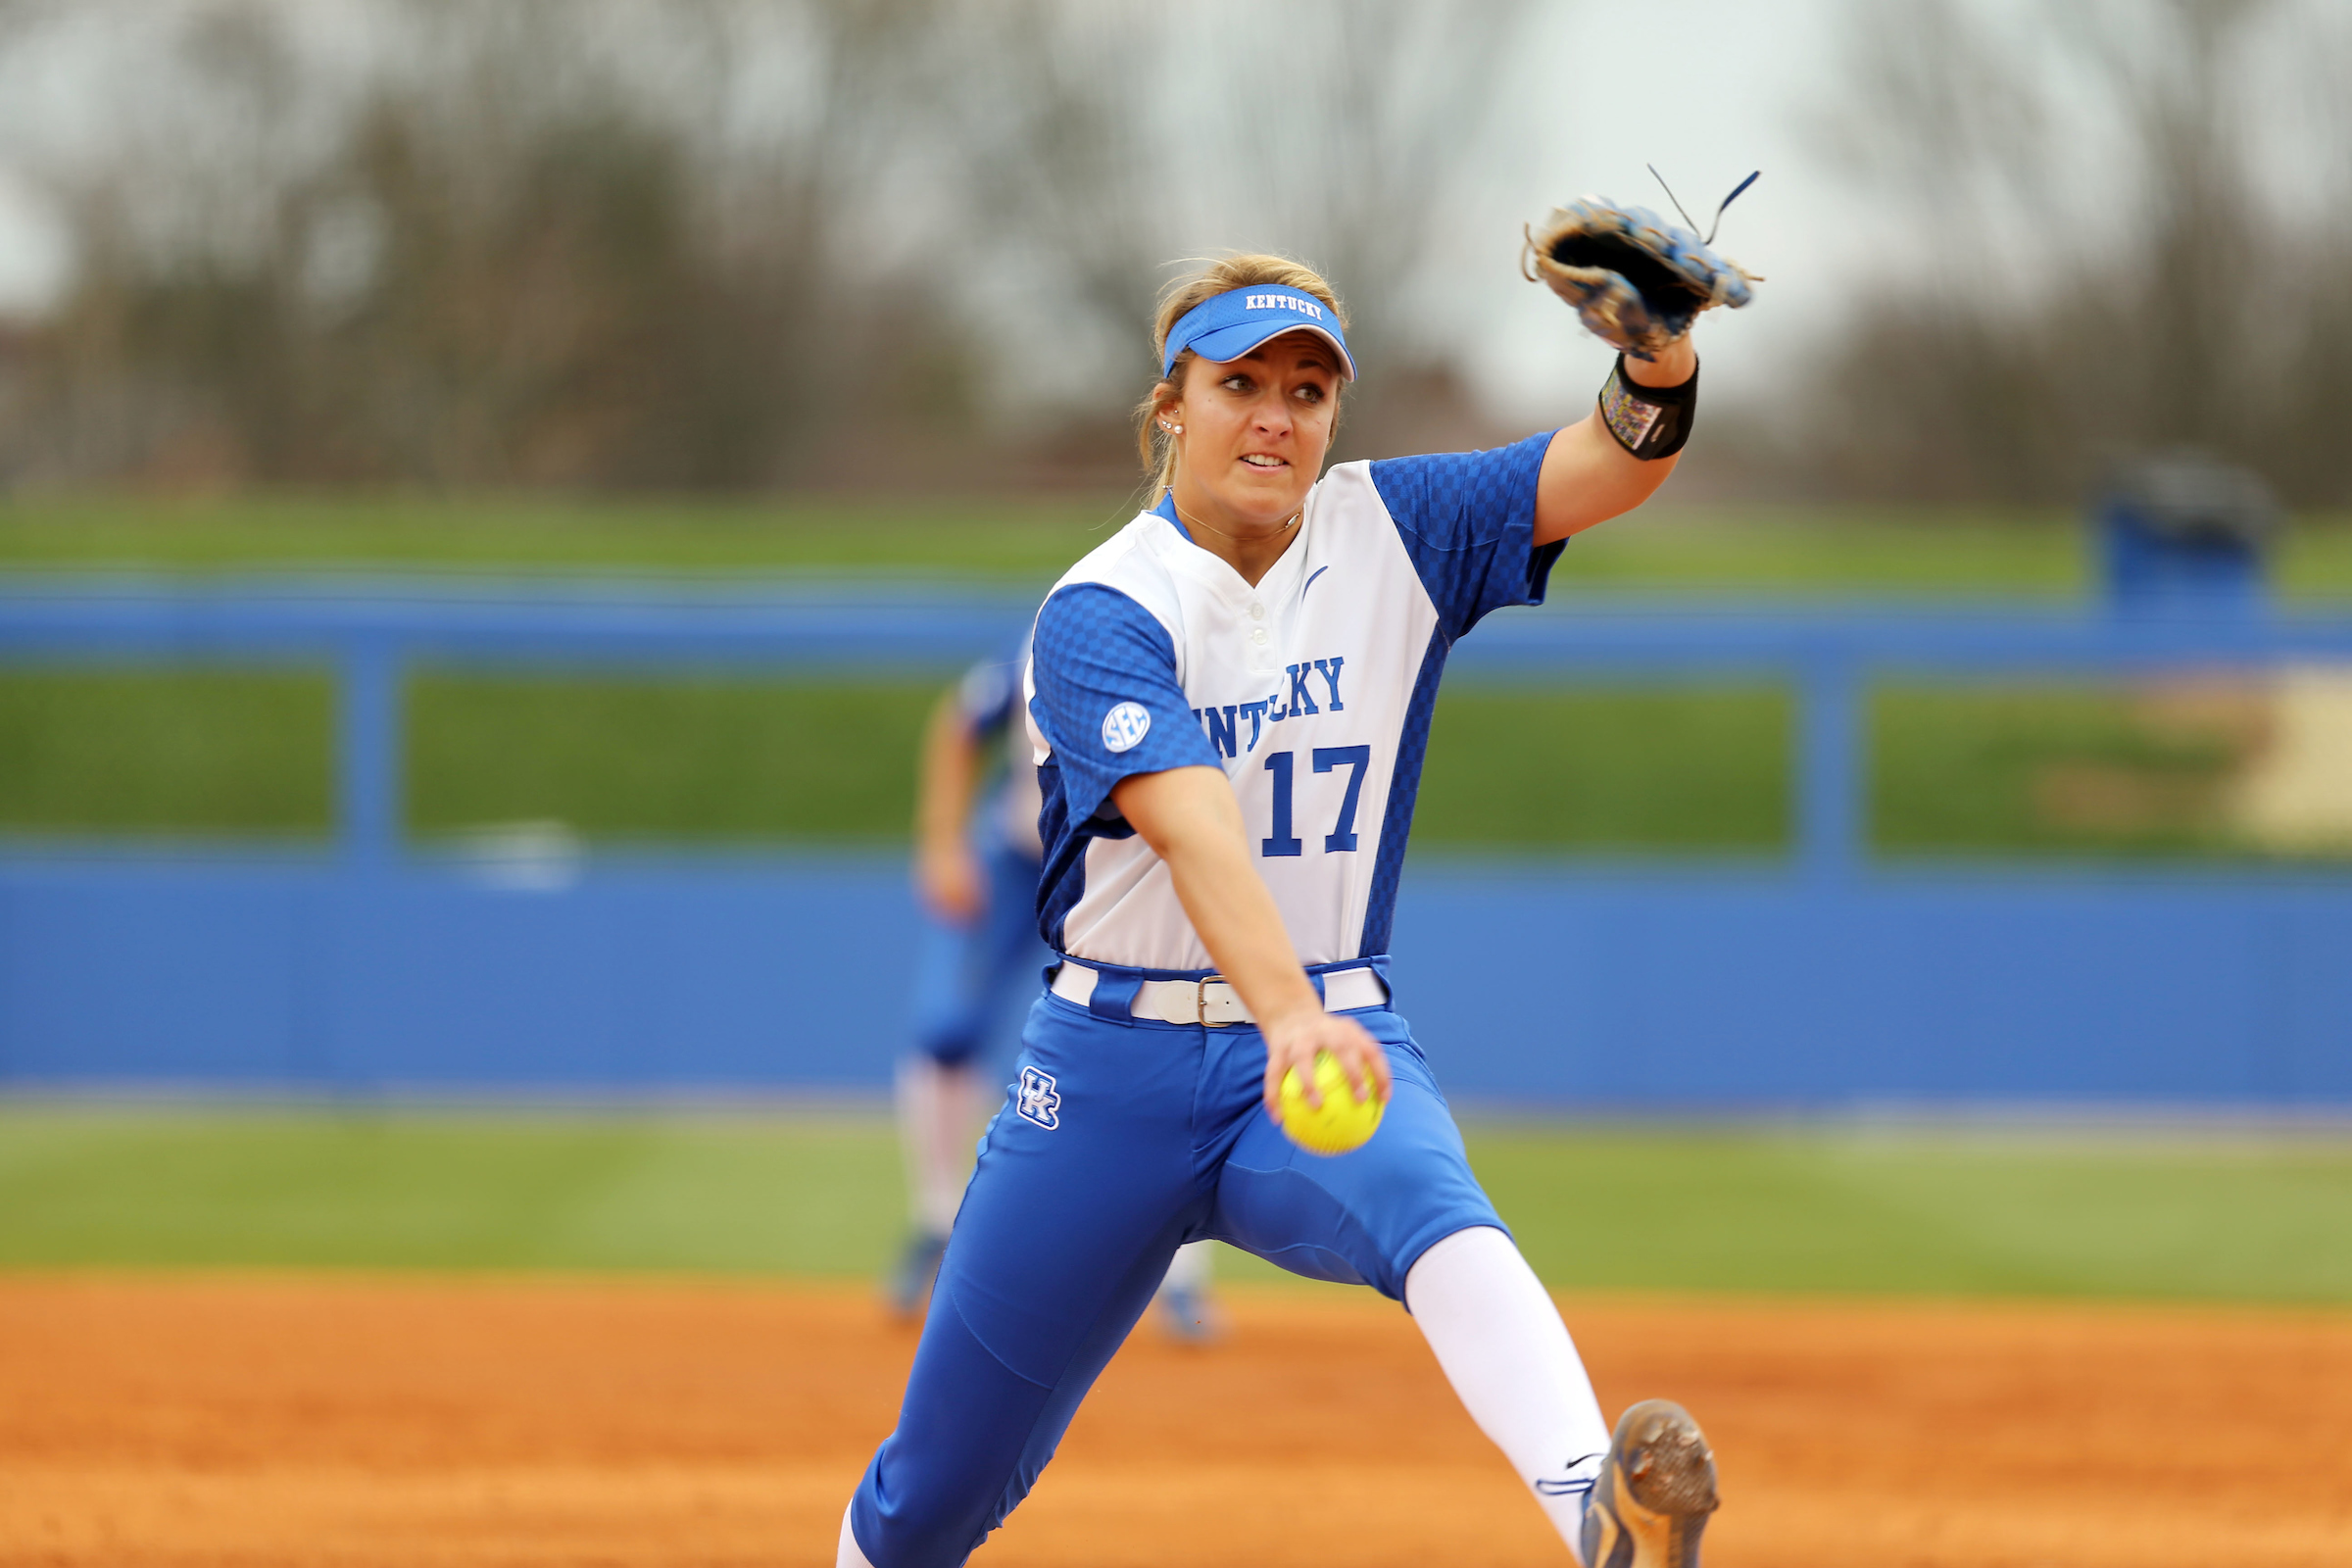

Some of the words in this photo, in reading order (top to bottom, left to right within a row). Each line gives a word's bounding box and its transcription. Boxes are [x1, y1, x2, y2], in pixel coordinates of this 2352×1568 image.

[1246, 294, 1322, 320] KENTUCKY
[1104, 704, 1148, 749] SEC
[1262, 745, 1370, 857] 17
[1019, 1069, 1058, 1127] UK
